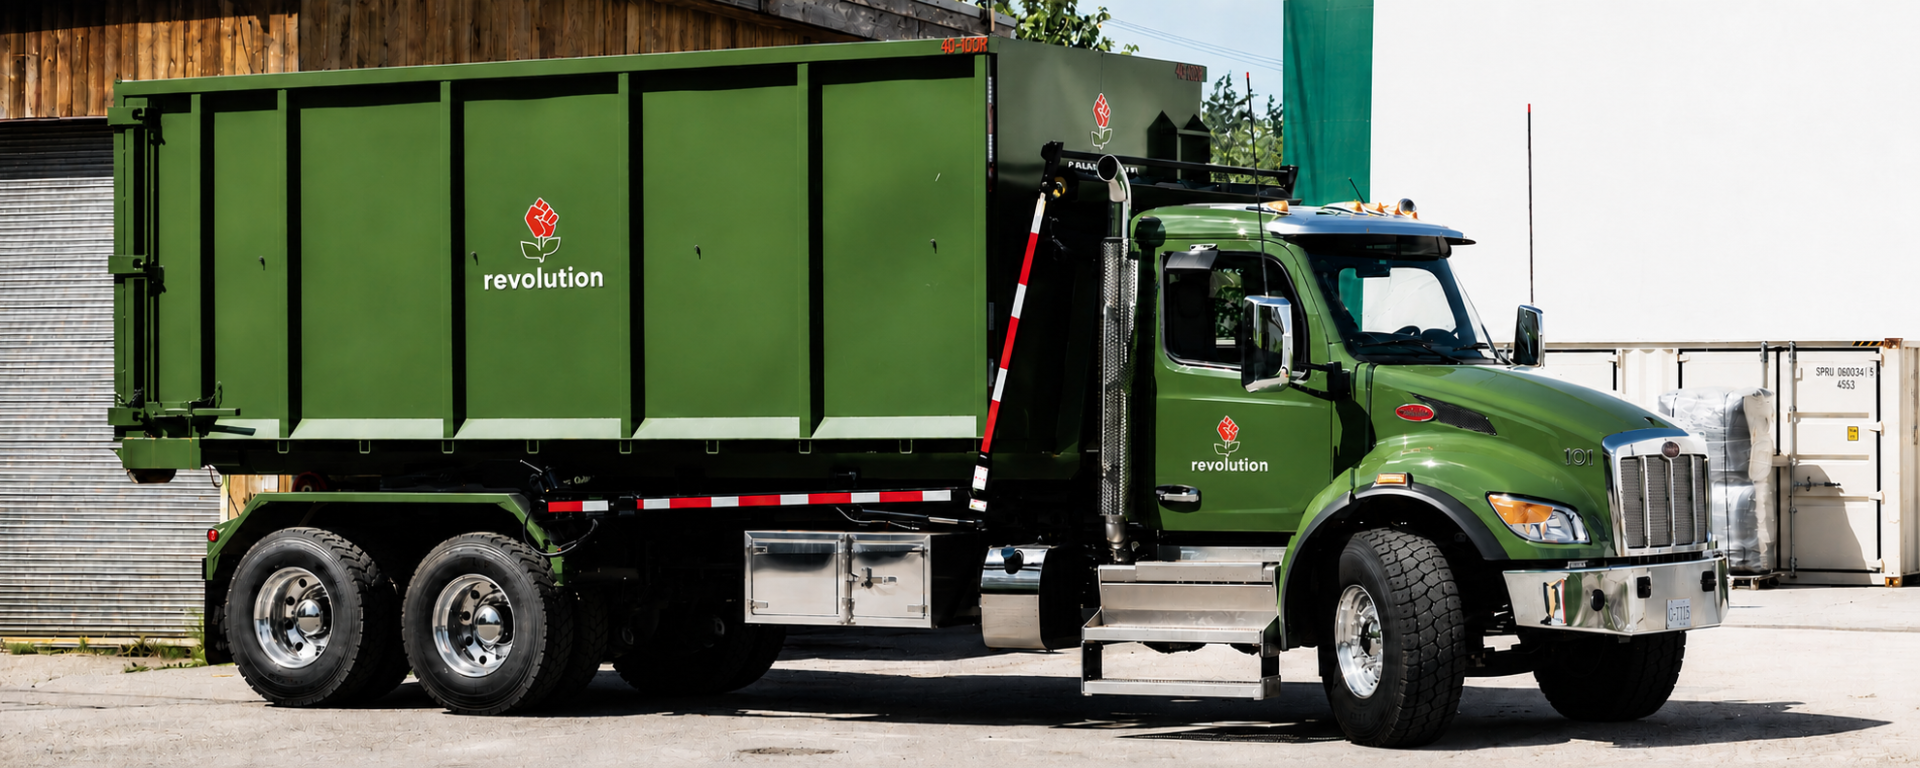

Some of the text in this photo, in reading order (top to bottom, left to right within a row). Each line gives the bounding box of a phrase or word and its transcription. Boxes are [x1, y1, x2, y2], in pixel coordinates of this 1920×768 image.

[484, 266, 604, 290] revolution
[1815, 366, 1835, 377] SPRU
[1836, 379, 1856, 390] 4553
[1563, 447, 1594, 466] 101
[1191, 457, 1269, 472] revolution
